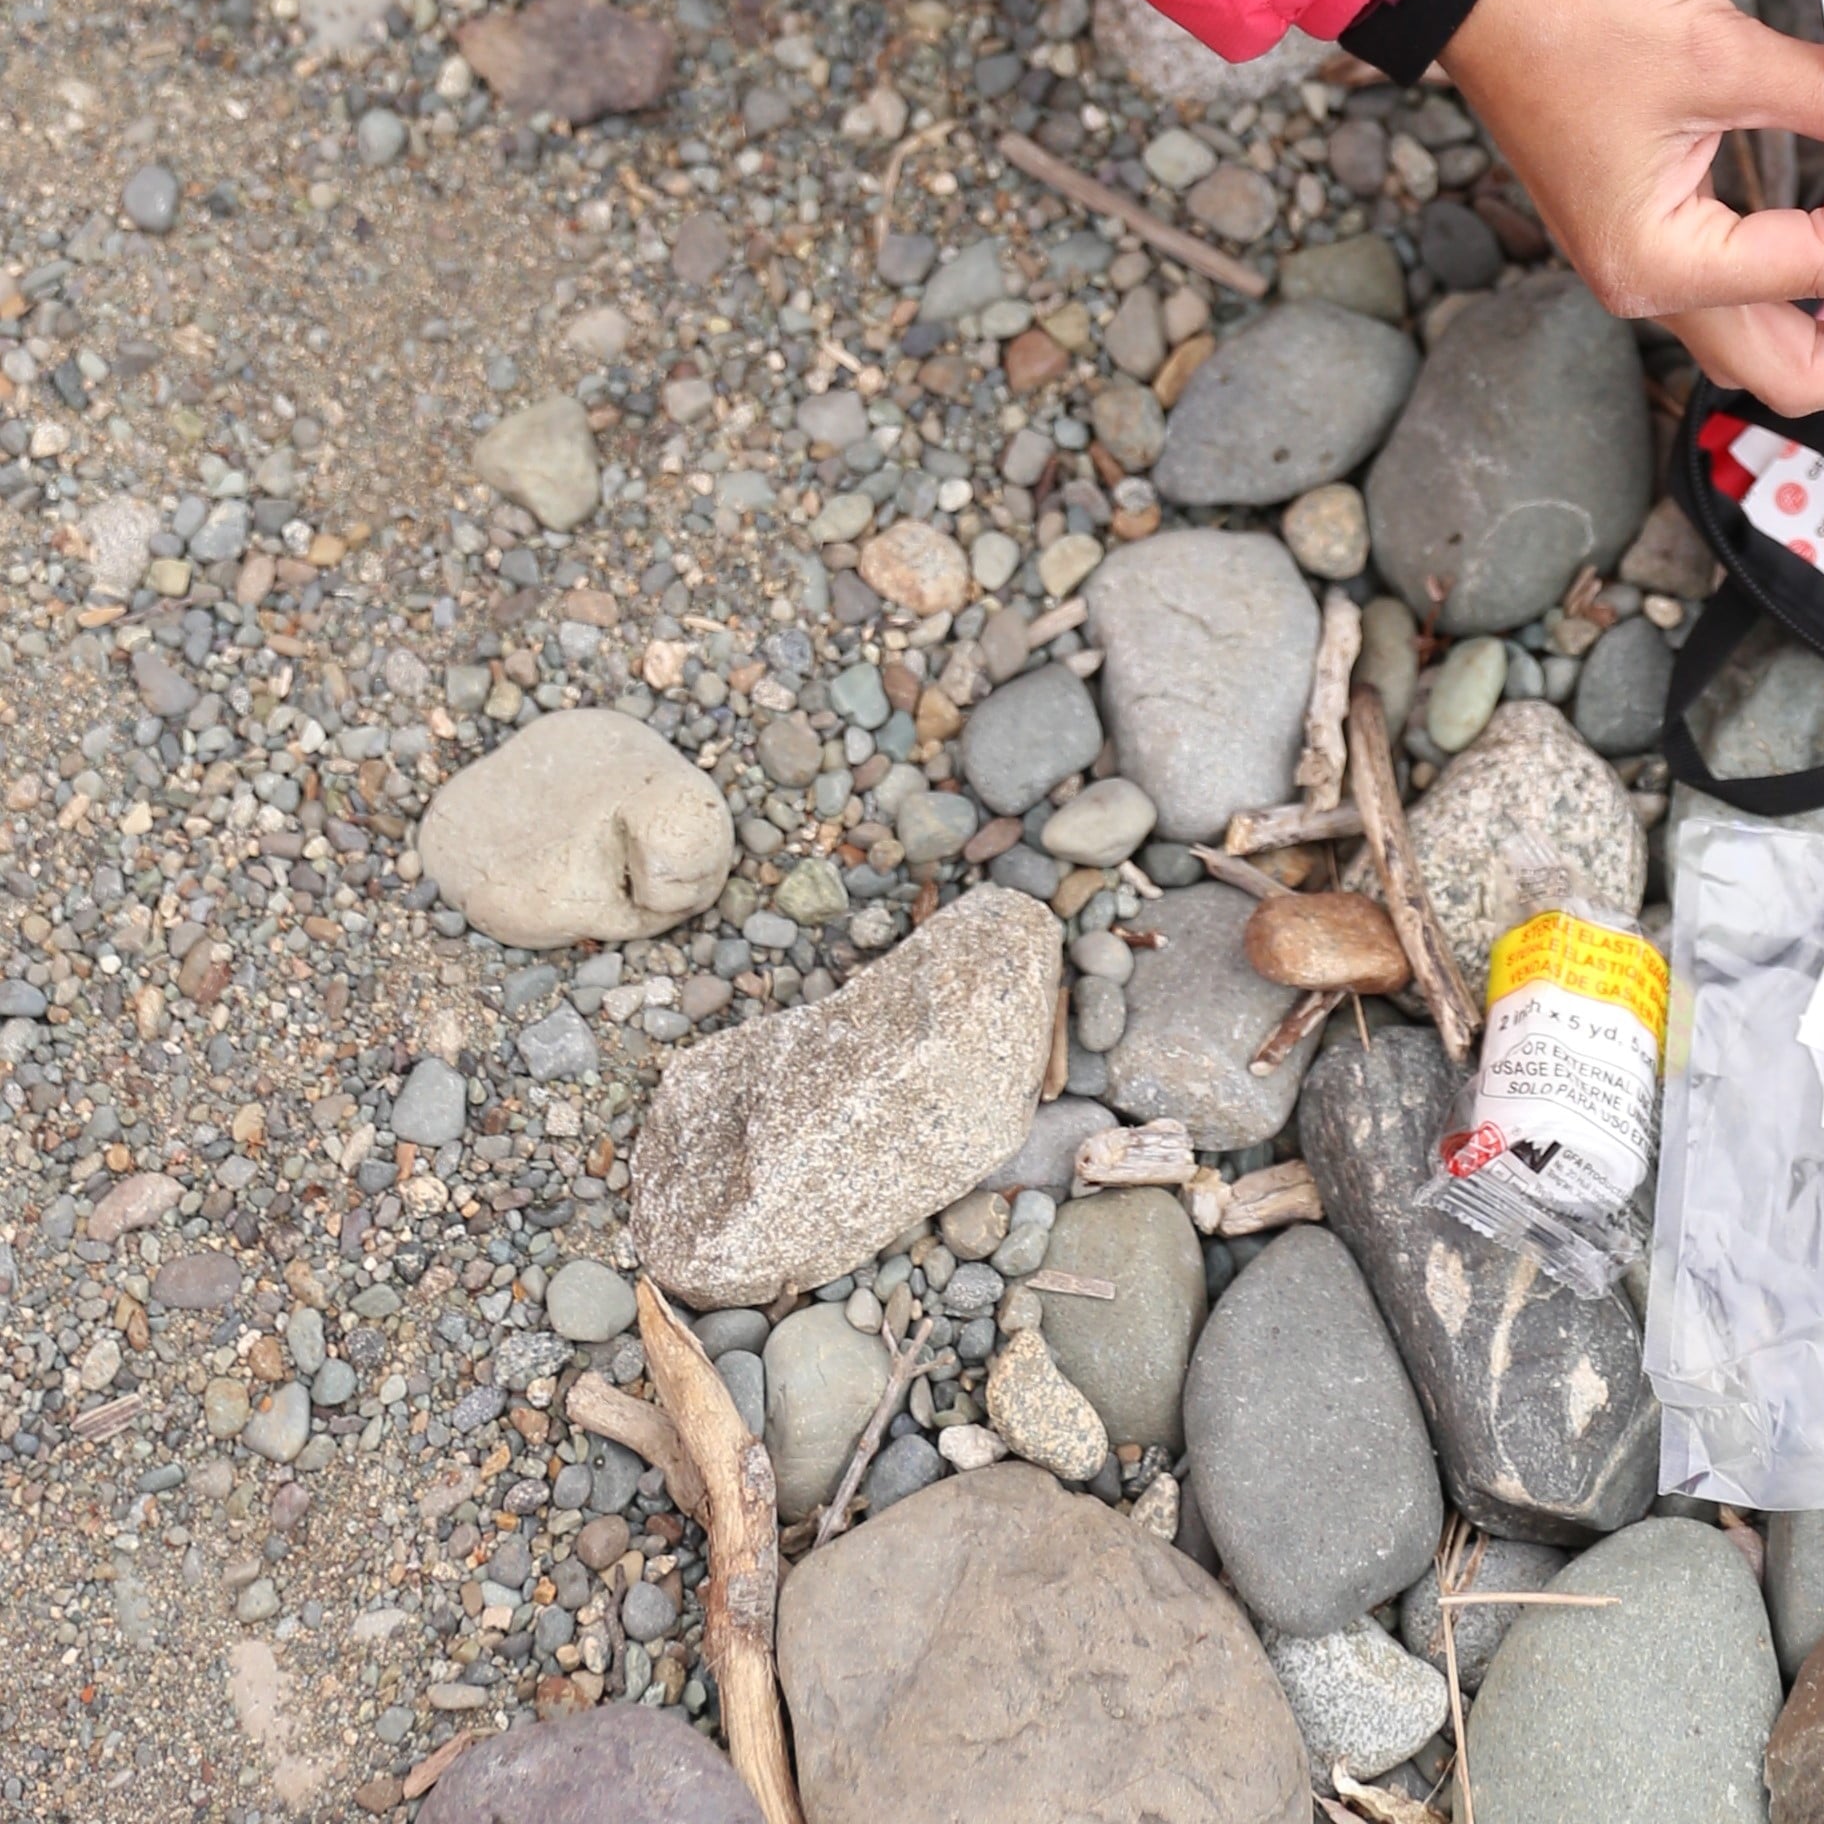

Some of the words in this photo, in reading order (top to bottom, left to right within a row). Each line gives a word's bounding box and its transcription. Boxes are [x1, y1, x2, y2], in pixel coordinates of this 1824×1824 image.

[1565, 970, 1589, 990] DE
[1499, 1015, 1510, 1031] 2
[1513, 998, 1541, 1026] inch
[1549, 1009, 1560, 1022] x
[1568, 1014, 1580, 1031] 5
[1631, 1036, 1640, 1053] 5
[1490, 1060, 1549, 1077] USAGE
[1553, 1063, 1626, 1111] EXTERNE
[1553, 1044, 1633, 1095] EXTERNAL
[1507, 1080, 1553, 1097] SOLO
[1556, 1082, 1598, 1116] PARA
[1600, 1109, 1631, 1136] USO
[1563, 1150, 1585, 1169] GFA
